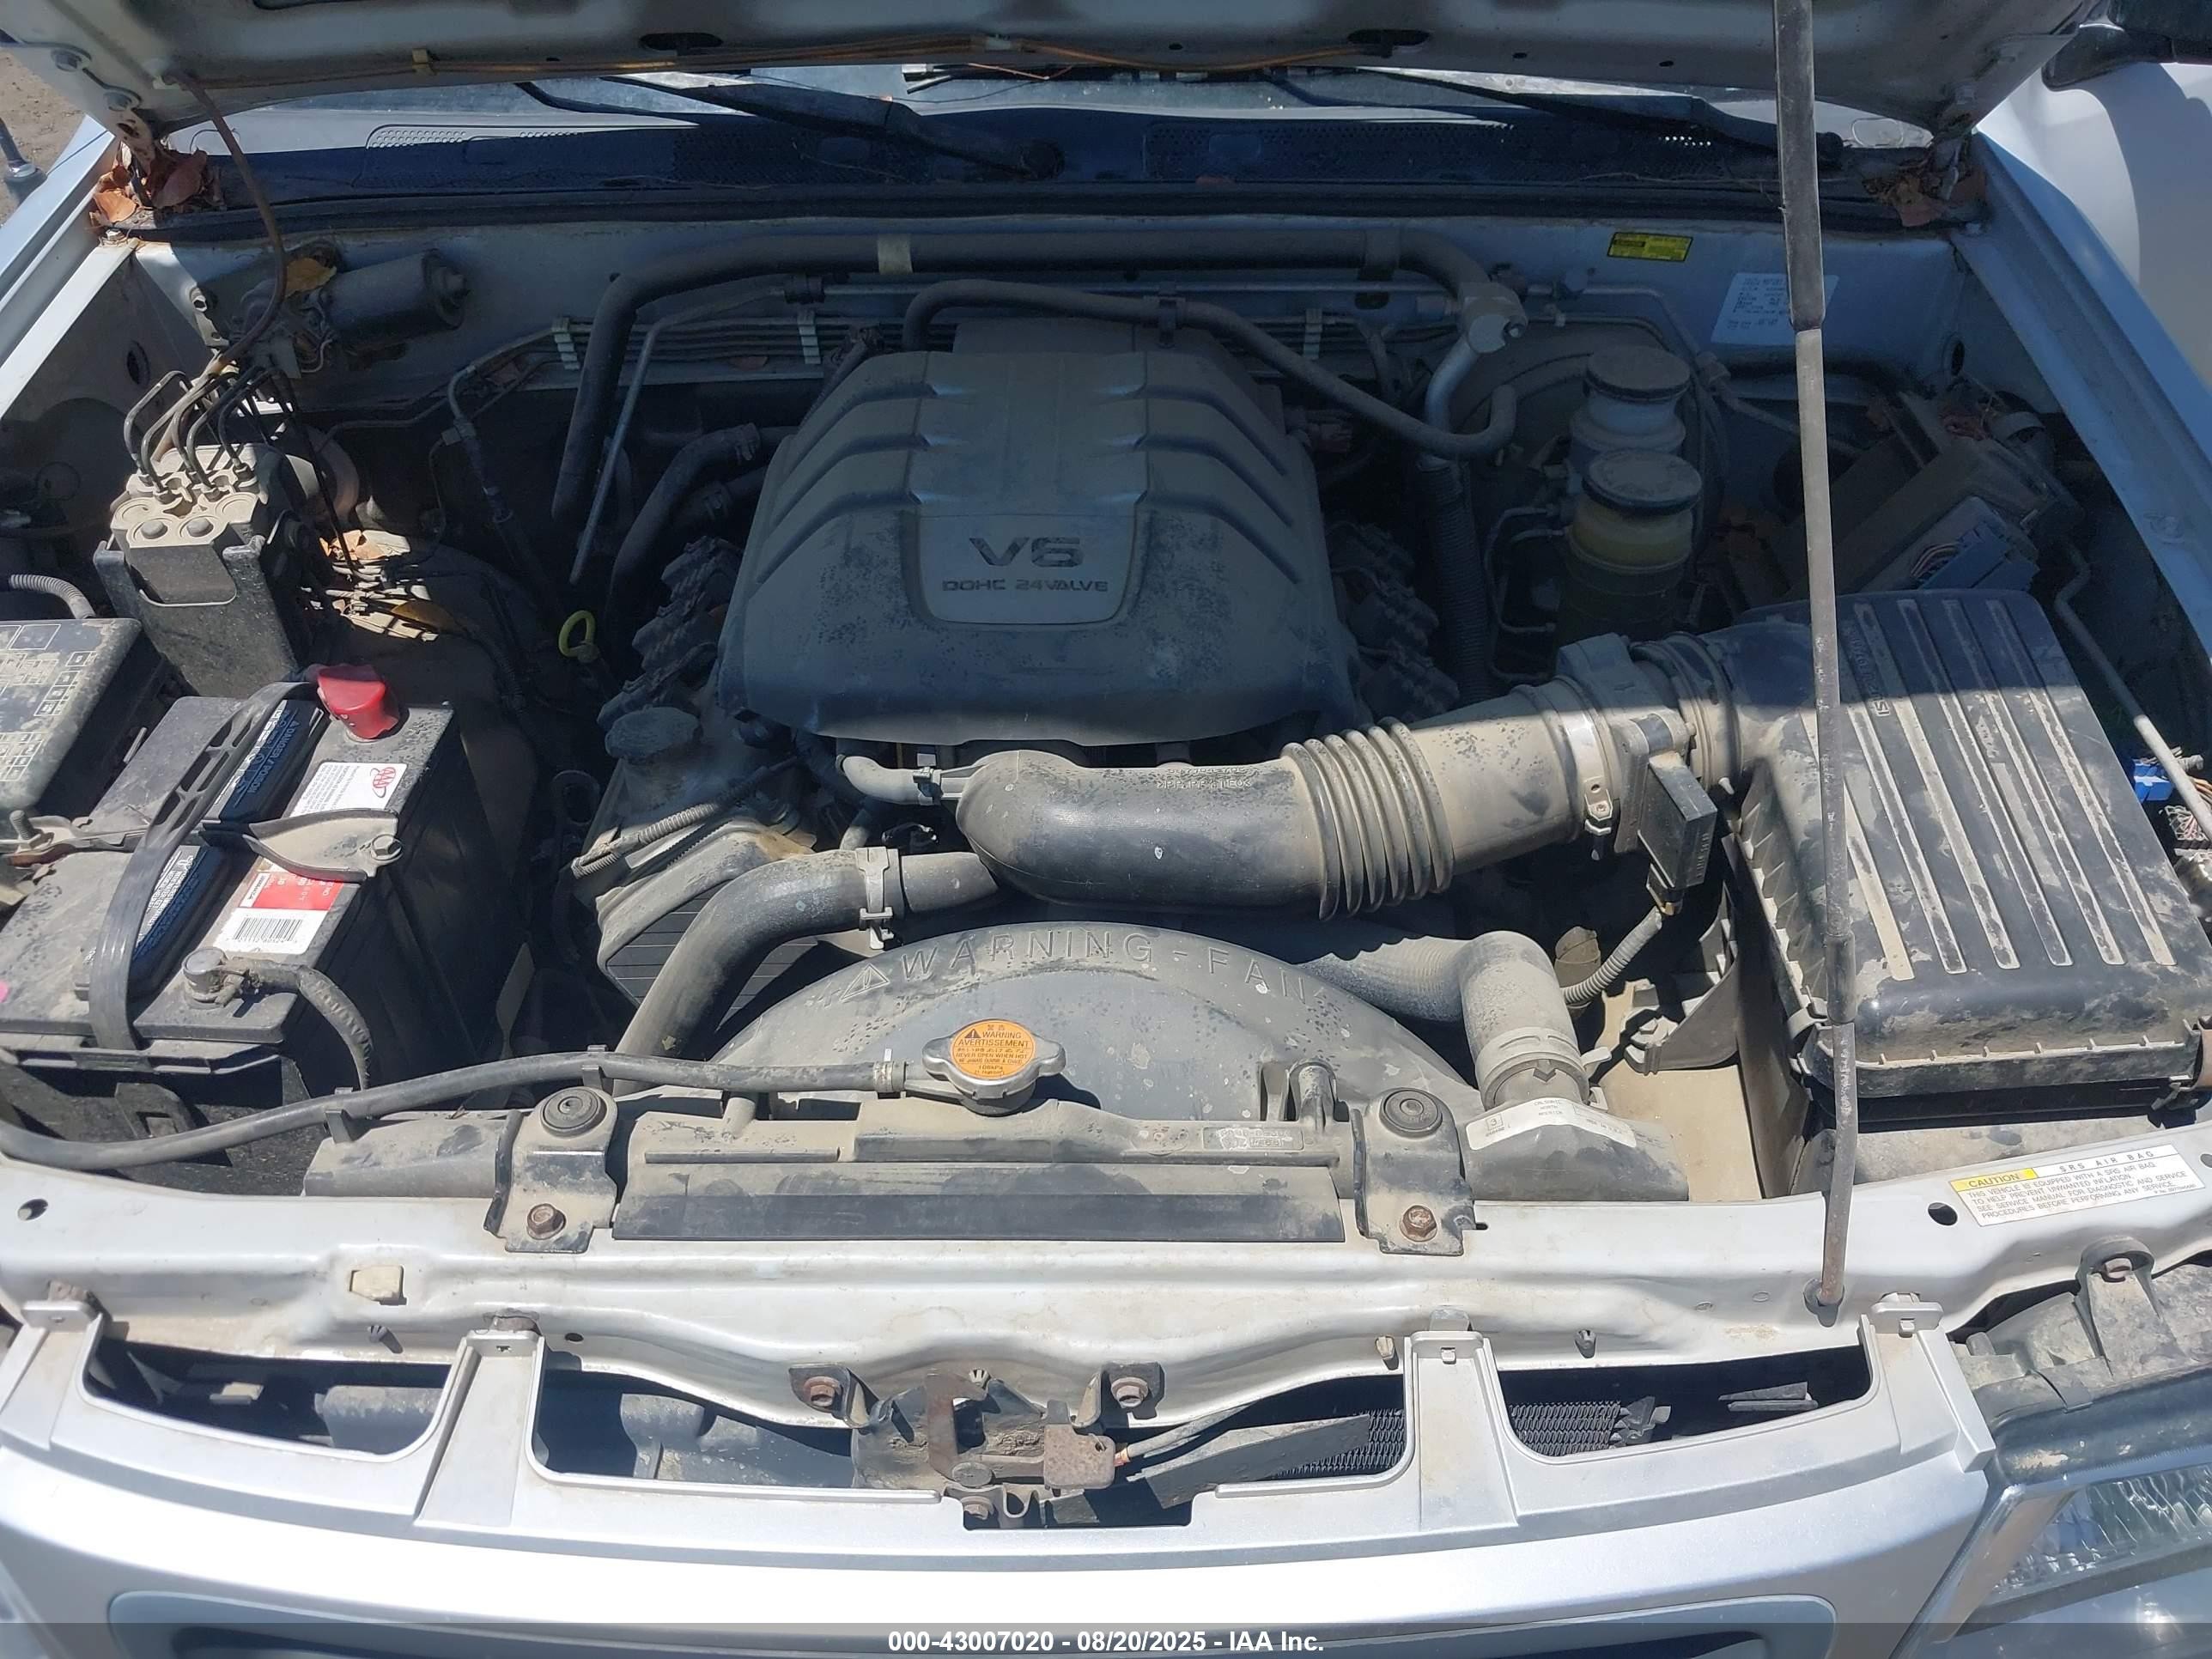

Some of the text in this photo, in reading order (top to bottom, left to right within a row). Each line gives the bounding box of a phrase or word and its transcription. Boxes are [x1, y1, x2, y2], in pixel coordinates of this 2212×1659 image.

[969, 536, 1085, 568] V6
[942, 579, 1006, 592] DOHC
[902, 930, 1152, 981] WARNING
[958, 1038, 1030, 1047] AVERTISSEMENT
[982, 1030, 1022, 1039] WARNING
[1968, 1150, 2154, 1188] CAUTION SRS AIR BAG
[1968, 1189, 1986, 1199] THIS
[1988, 1184, 2021, 1195] VEHICLE
[2033, 1176, 2072, 1188] EQUIPPED
[2074, 1172, 2094, 1183] WITH
[2105, 1167, 2121, 1176] SRS
[2124, 1164, 2136, 1173] AIR
[1972, 1197, 1984, 1206] TO
[1987, 1193, 2007, 1203] HELP
[2009, 1187, 2046, 1200] PREVENT
[2048, 1180, 2092, 1193] UNWANTED
[1977, 1170, 2187, 1212] SEE SERVICE MANUAL FOR DIAGNOSTIC AND SERVICE
[1981, 1205, 2036, 1218] PROCEDURES
[2038, 1199, 2070, 1211] BEFORE
[2124, 1186, 2140, 1196] ANY
